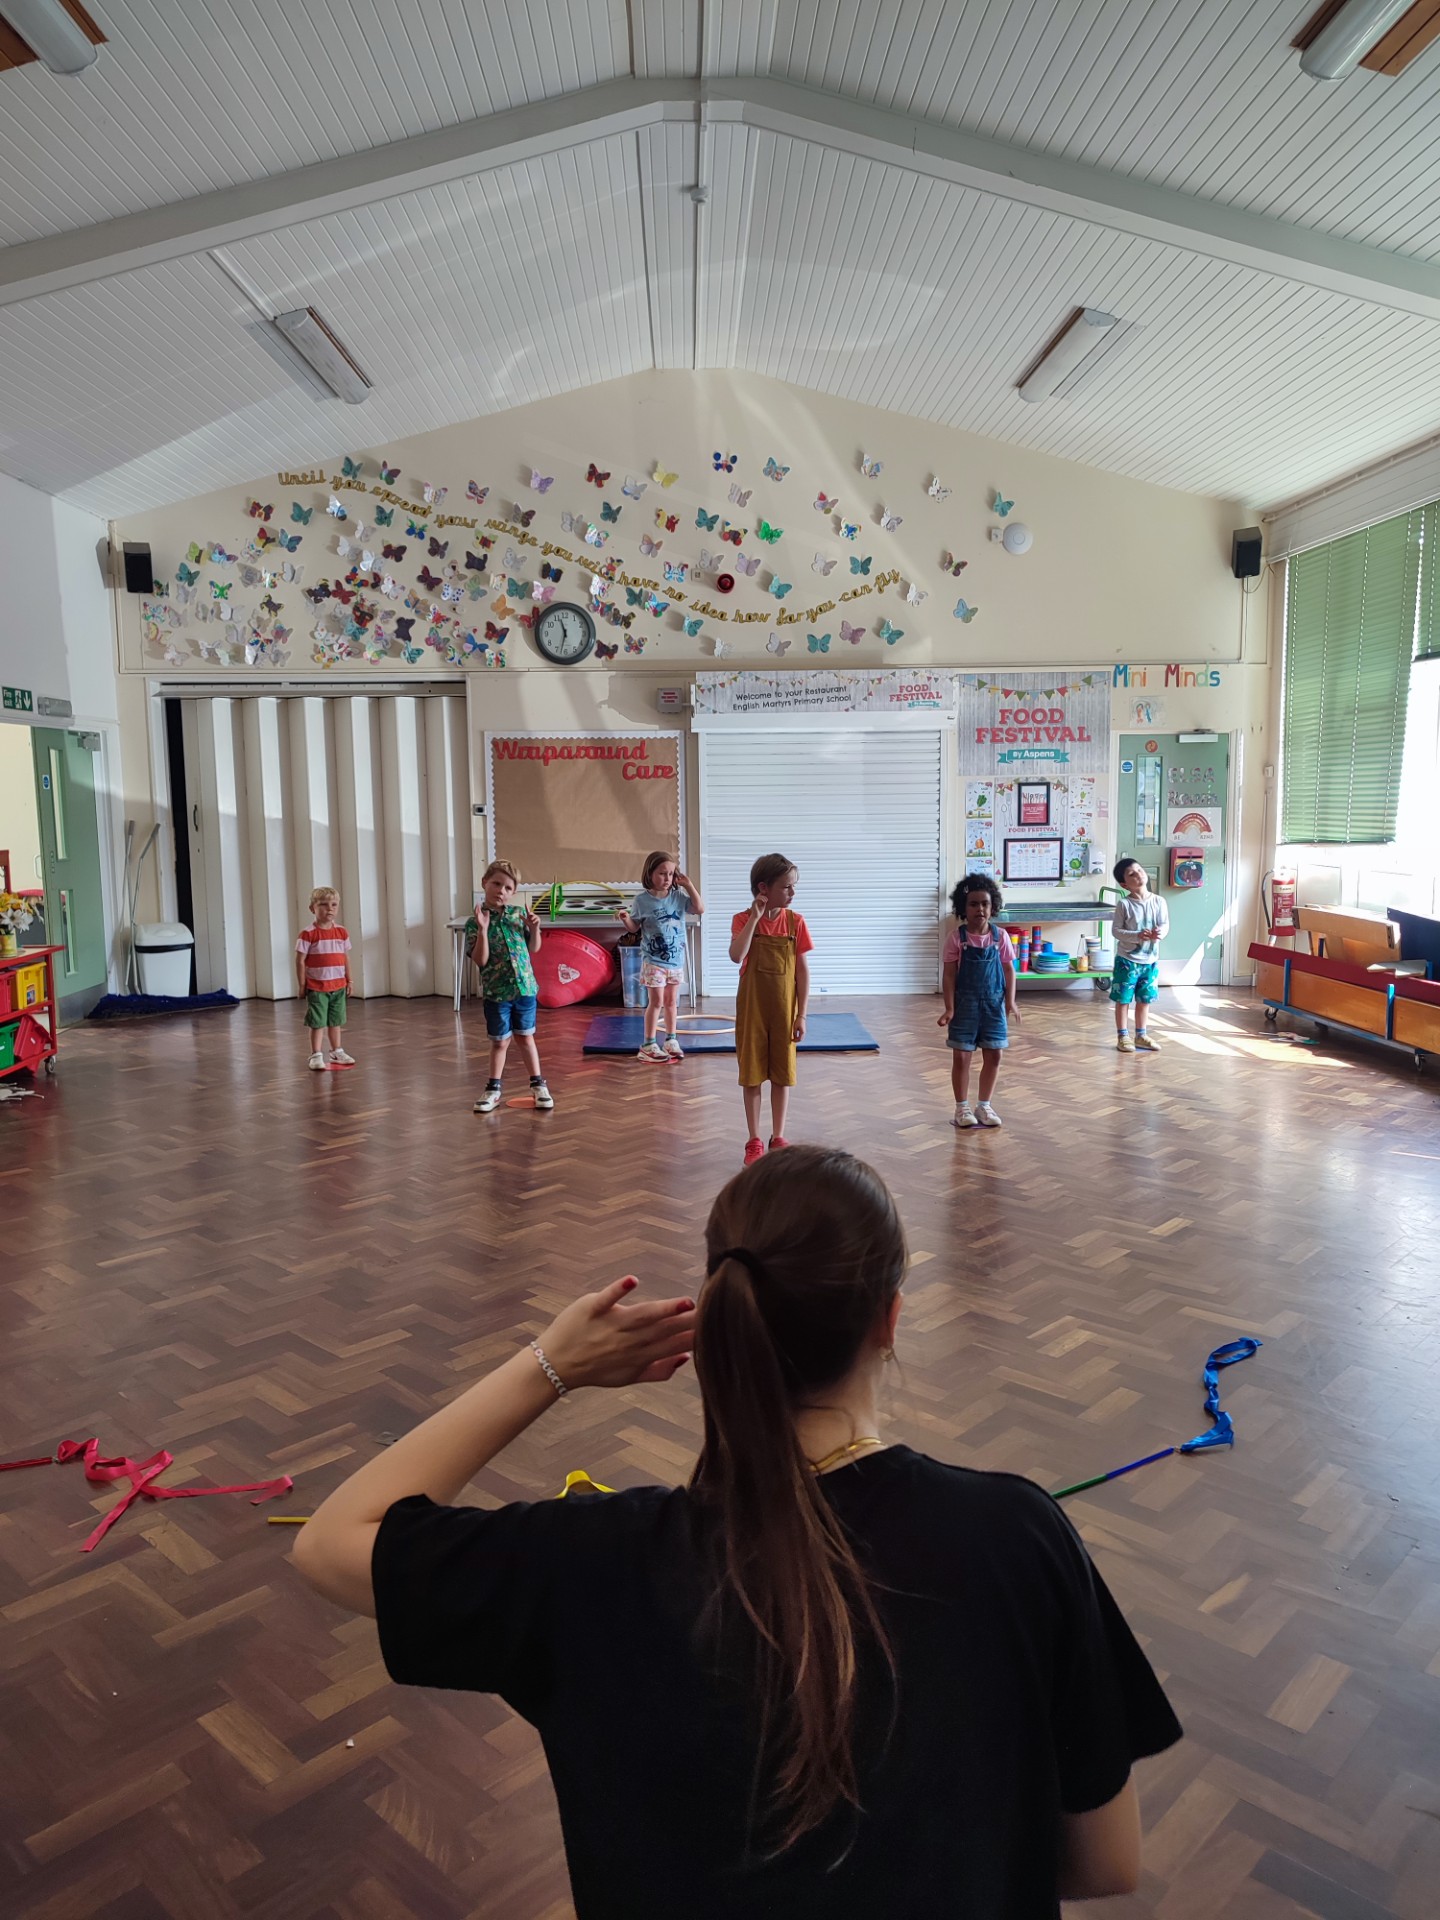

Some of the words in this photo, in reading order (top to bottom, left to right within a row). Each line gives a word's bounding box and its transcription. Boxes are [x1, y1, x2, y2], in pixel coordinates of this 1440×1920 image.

[278, 469, 326, 485] Until
[329, 475, 367, 492] you
[370, 486, 432, 518] spread
[434, 514, 478, 528] your
[484, 518, 538, 547] wings
[540, 541, 573, 562] you
[575, 556, 611, 581] wi
[616, 571, 659, 591] have
[662, 586, 688, 602] no
[689, 600, 728, 621] idea
[732, 609, 771, 623] how
[776, 607, 805, 626] far
[806, 600, 836, 623] you
[839, 584, 873, 602] can
[874, 569, 900, 594] fly
[1113, 664, 1147, 688] Mini
[1165, 661, 1220, 688] Minds
[736, 693, 772, 701] Welcome
[785, 690, 803, 698] your
[805, 685, 847, 695] Restaurant
[889, 691, 942, 702] FESTIVAL
[899, 684, 929, 693] FOOD
[733, 701, 760, 711] English
[763, 700, 791, 709] Martyrs
[794, 697, 824, 706] Primary
[827, 694, 852, 703] School
[999, 708, 1064, 725] FOOD
[975, 726, 1091, 744] FESTIVAL
[493, 740, 649, 766] Wraparound
[1023, 750, 1055, 759] Aspens
[622, 762, 677, 780] Care
